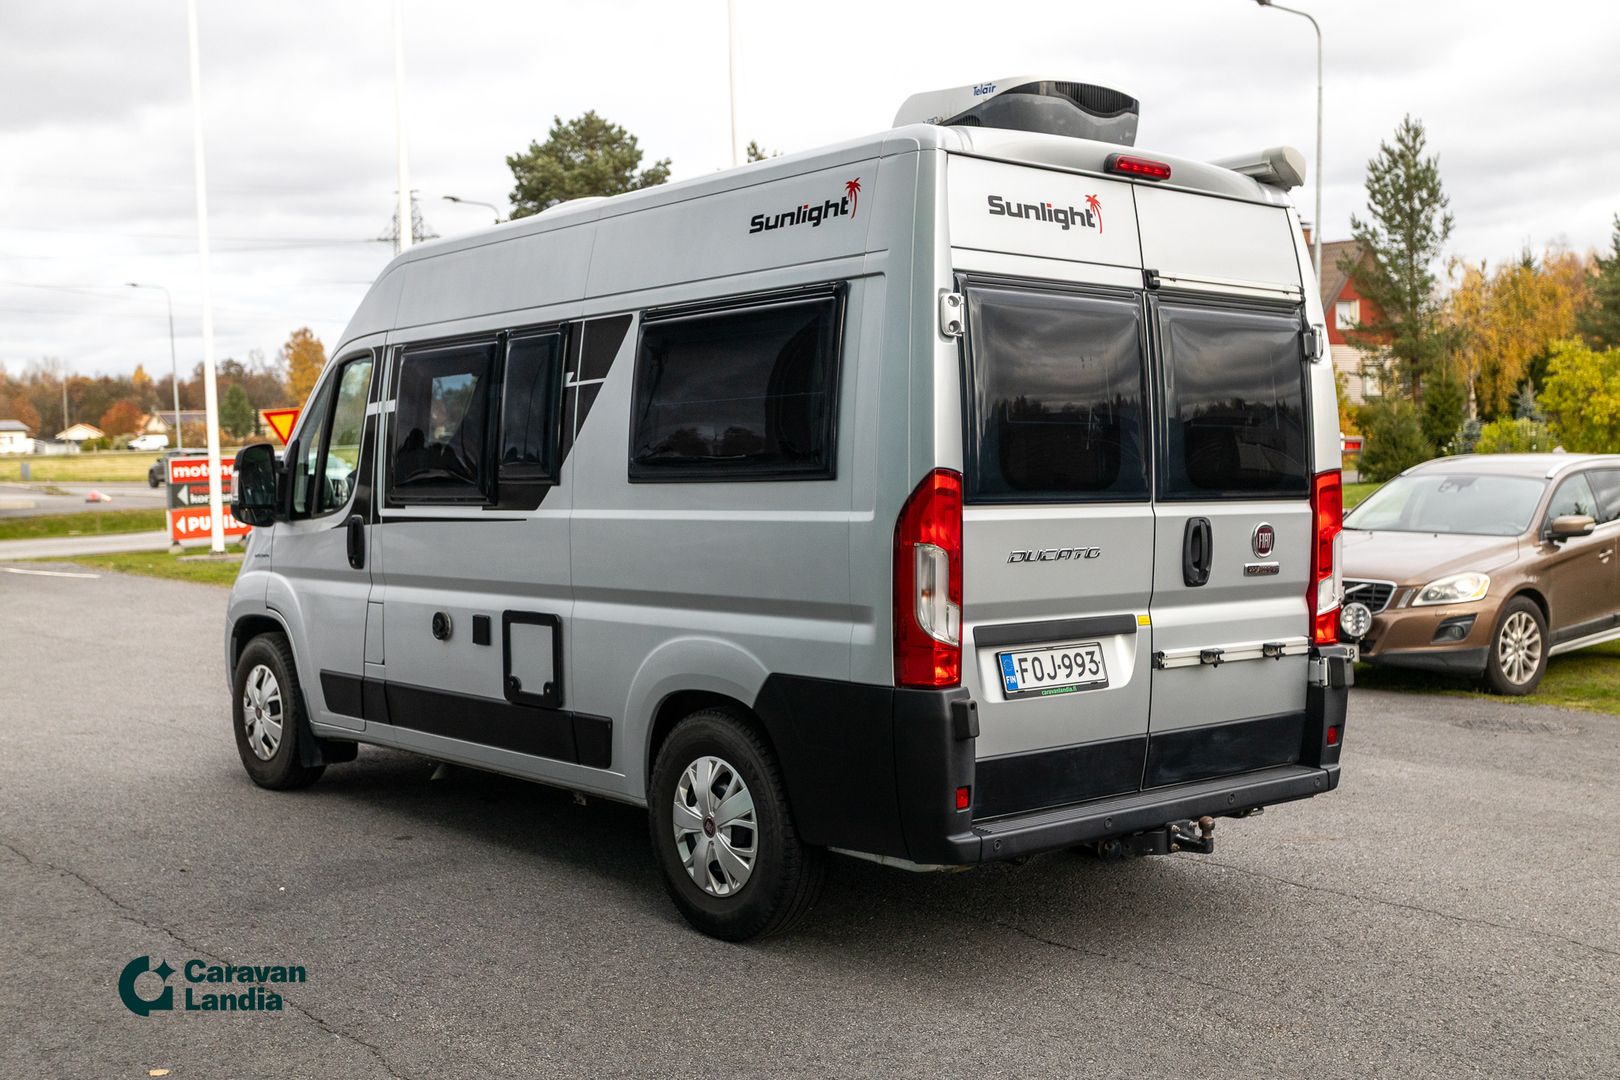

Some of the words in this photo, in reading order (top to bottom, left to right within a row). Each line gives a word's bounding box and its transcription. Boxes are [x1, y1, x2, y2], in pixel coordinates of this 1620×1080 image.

[973, 83, 997, 96] Telair
[749, 196, 850, 234] Sunlight
[988, 195, 1096, 230] Sunlight
[1258, 532, 1272, 549] FIAT
[1007, 547, 1101, 563] DUCATO
[1018, 650, 1100, 684] FOJ-993
[1006, 675, 1017, 684] FIN
[1041, 685, 1078, 696] caravanlandia.fi
